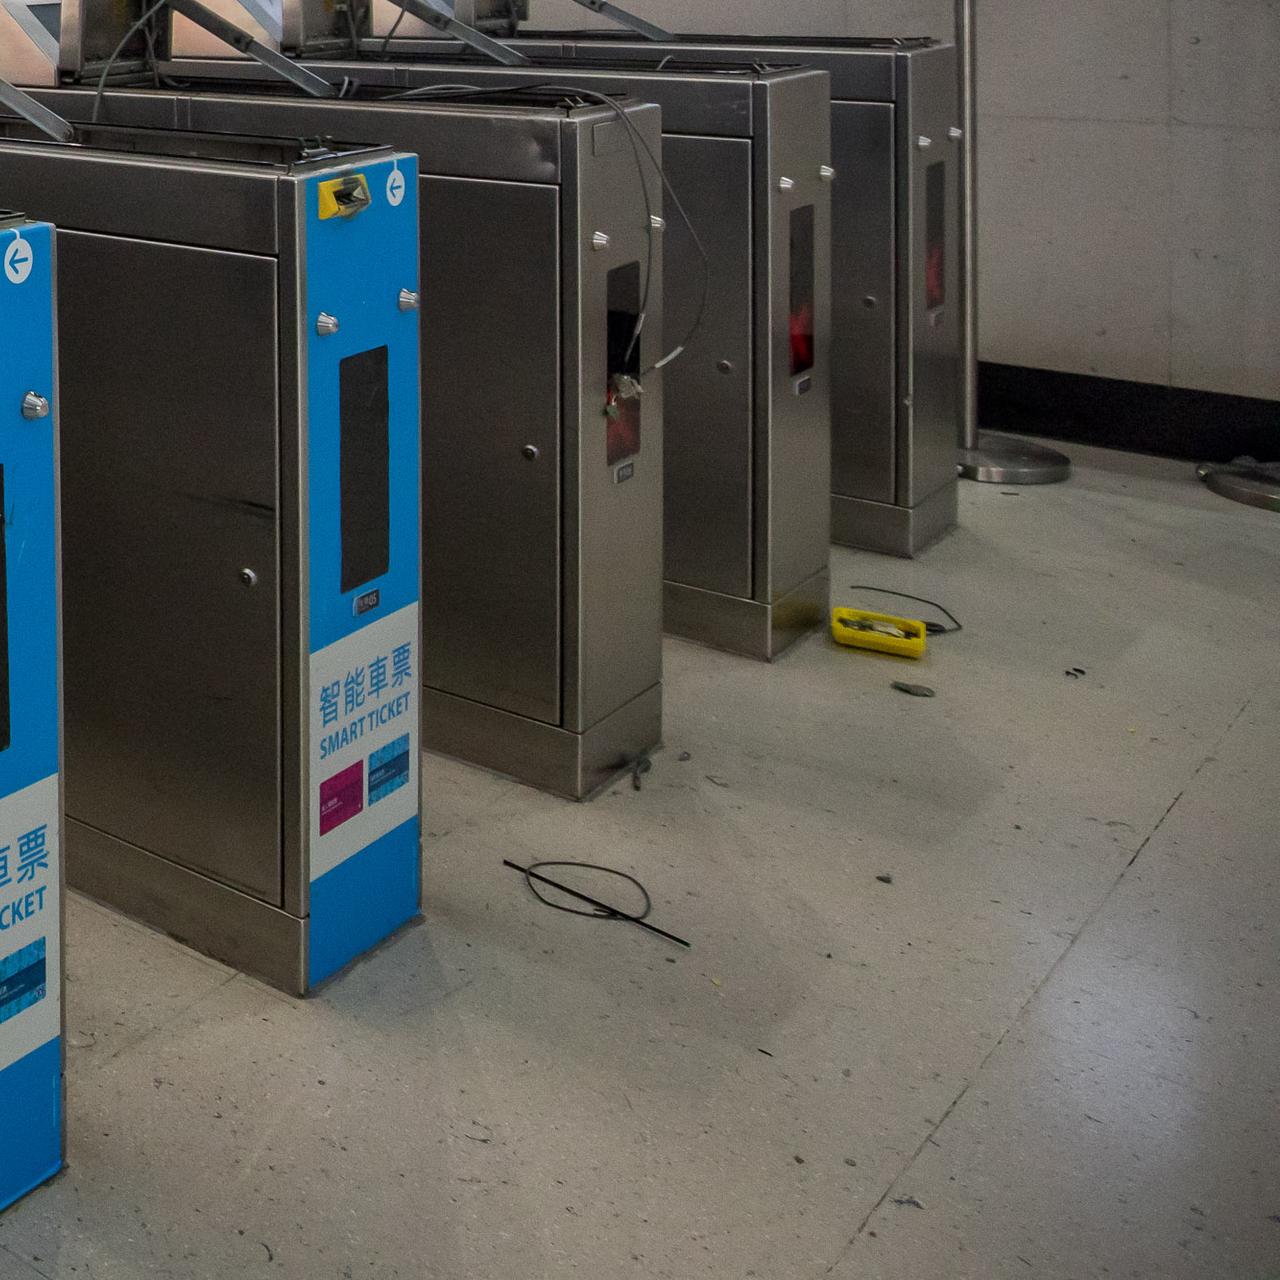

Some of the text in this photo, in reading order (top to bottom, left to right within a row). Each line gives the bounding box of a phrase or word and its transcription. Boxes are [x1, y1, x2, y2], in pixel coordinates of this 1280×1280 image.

[319, 641, 412, 728] 智能車票
[320, 691, 410, 761] SMART TICKET
